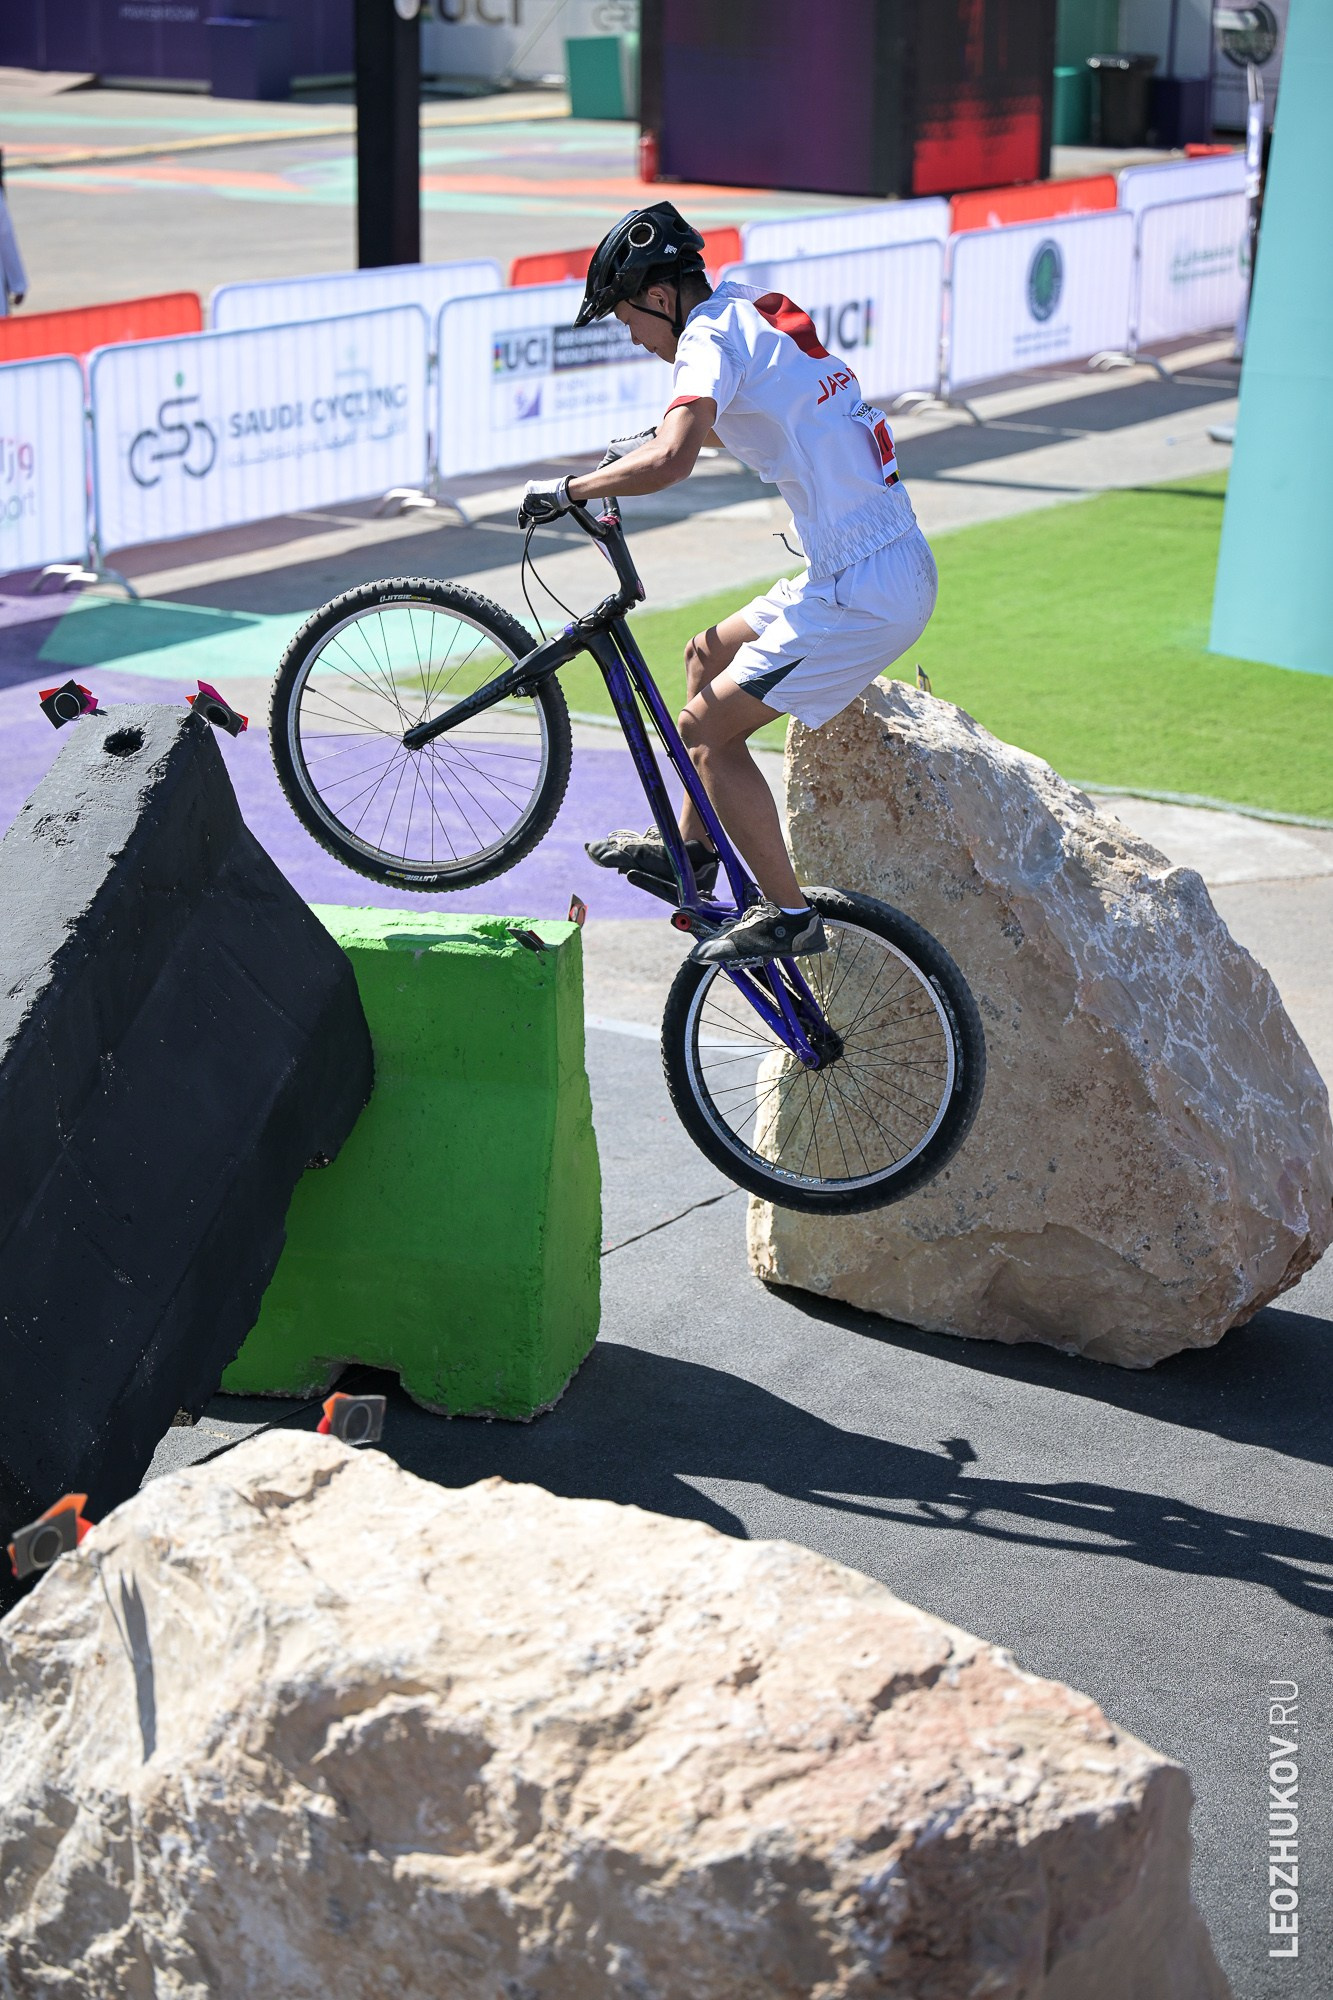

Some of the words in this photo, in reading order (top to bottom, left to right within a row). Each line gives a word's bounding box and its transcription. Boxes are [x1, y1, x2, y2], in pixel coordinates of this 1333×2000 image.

[505, 338, 547, 369] UCI
[228, 399, 303, 439] SAUDI
[310, 383, 407, 424] CYCLING
